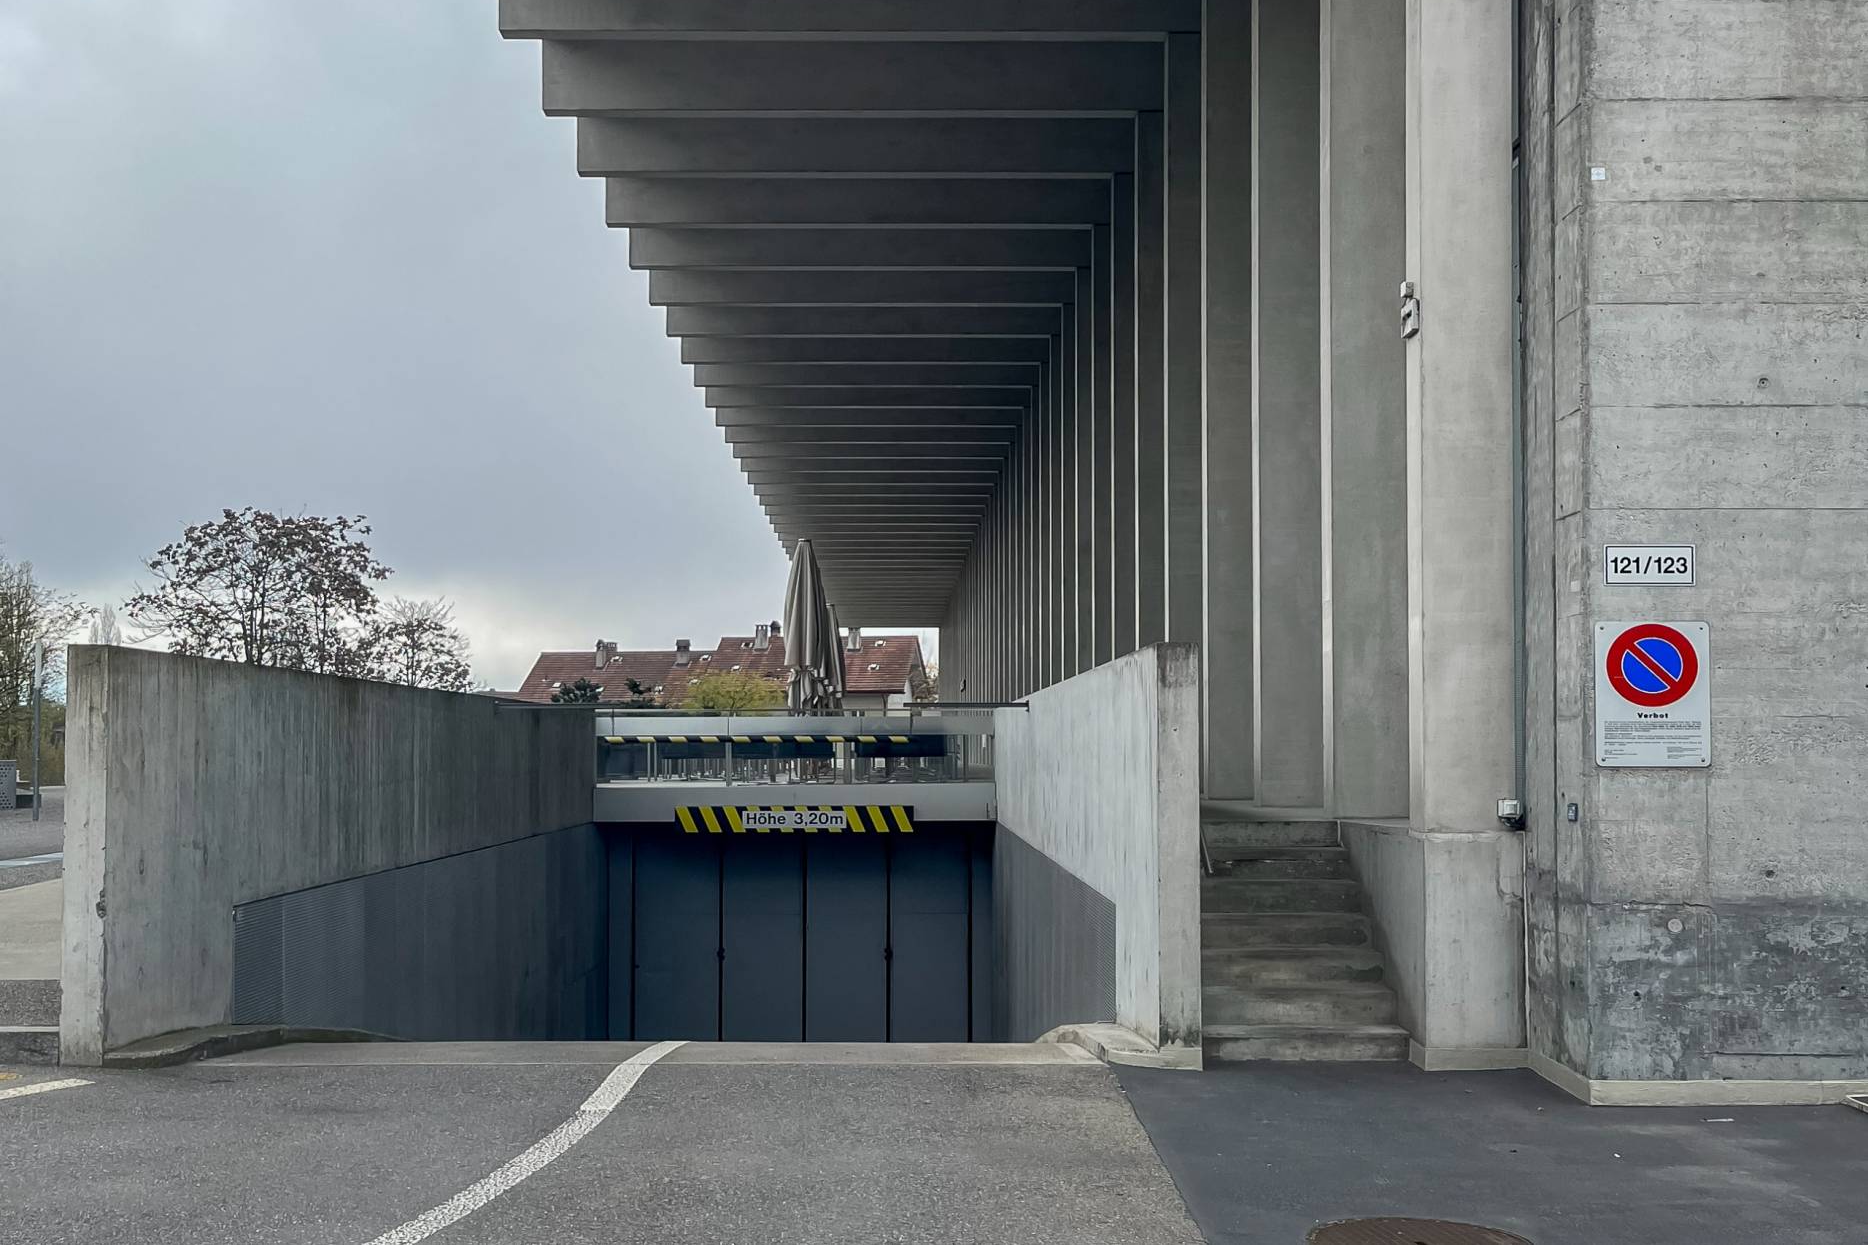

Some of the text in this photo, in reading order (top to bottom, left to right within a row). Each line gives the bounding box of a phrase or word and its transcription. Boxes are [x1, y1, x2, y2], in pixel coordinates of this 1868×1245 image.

[1610, 556, 1688, 574] 121/123
[746, 812, 843, 826] Höhe 3,20m
